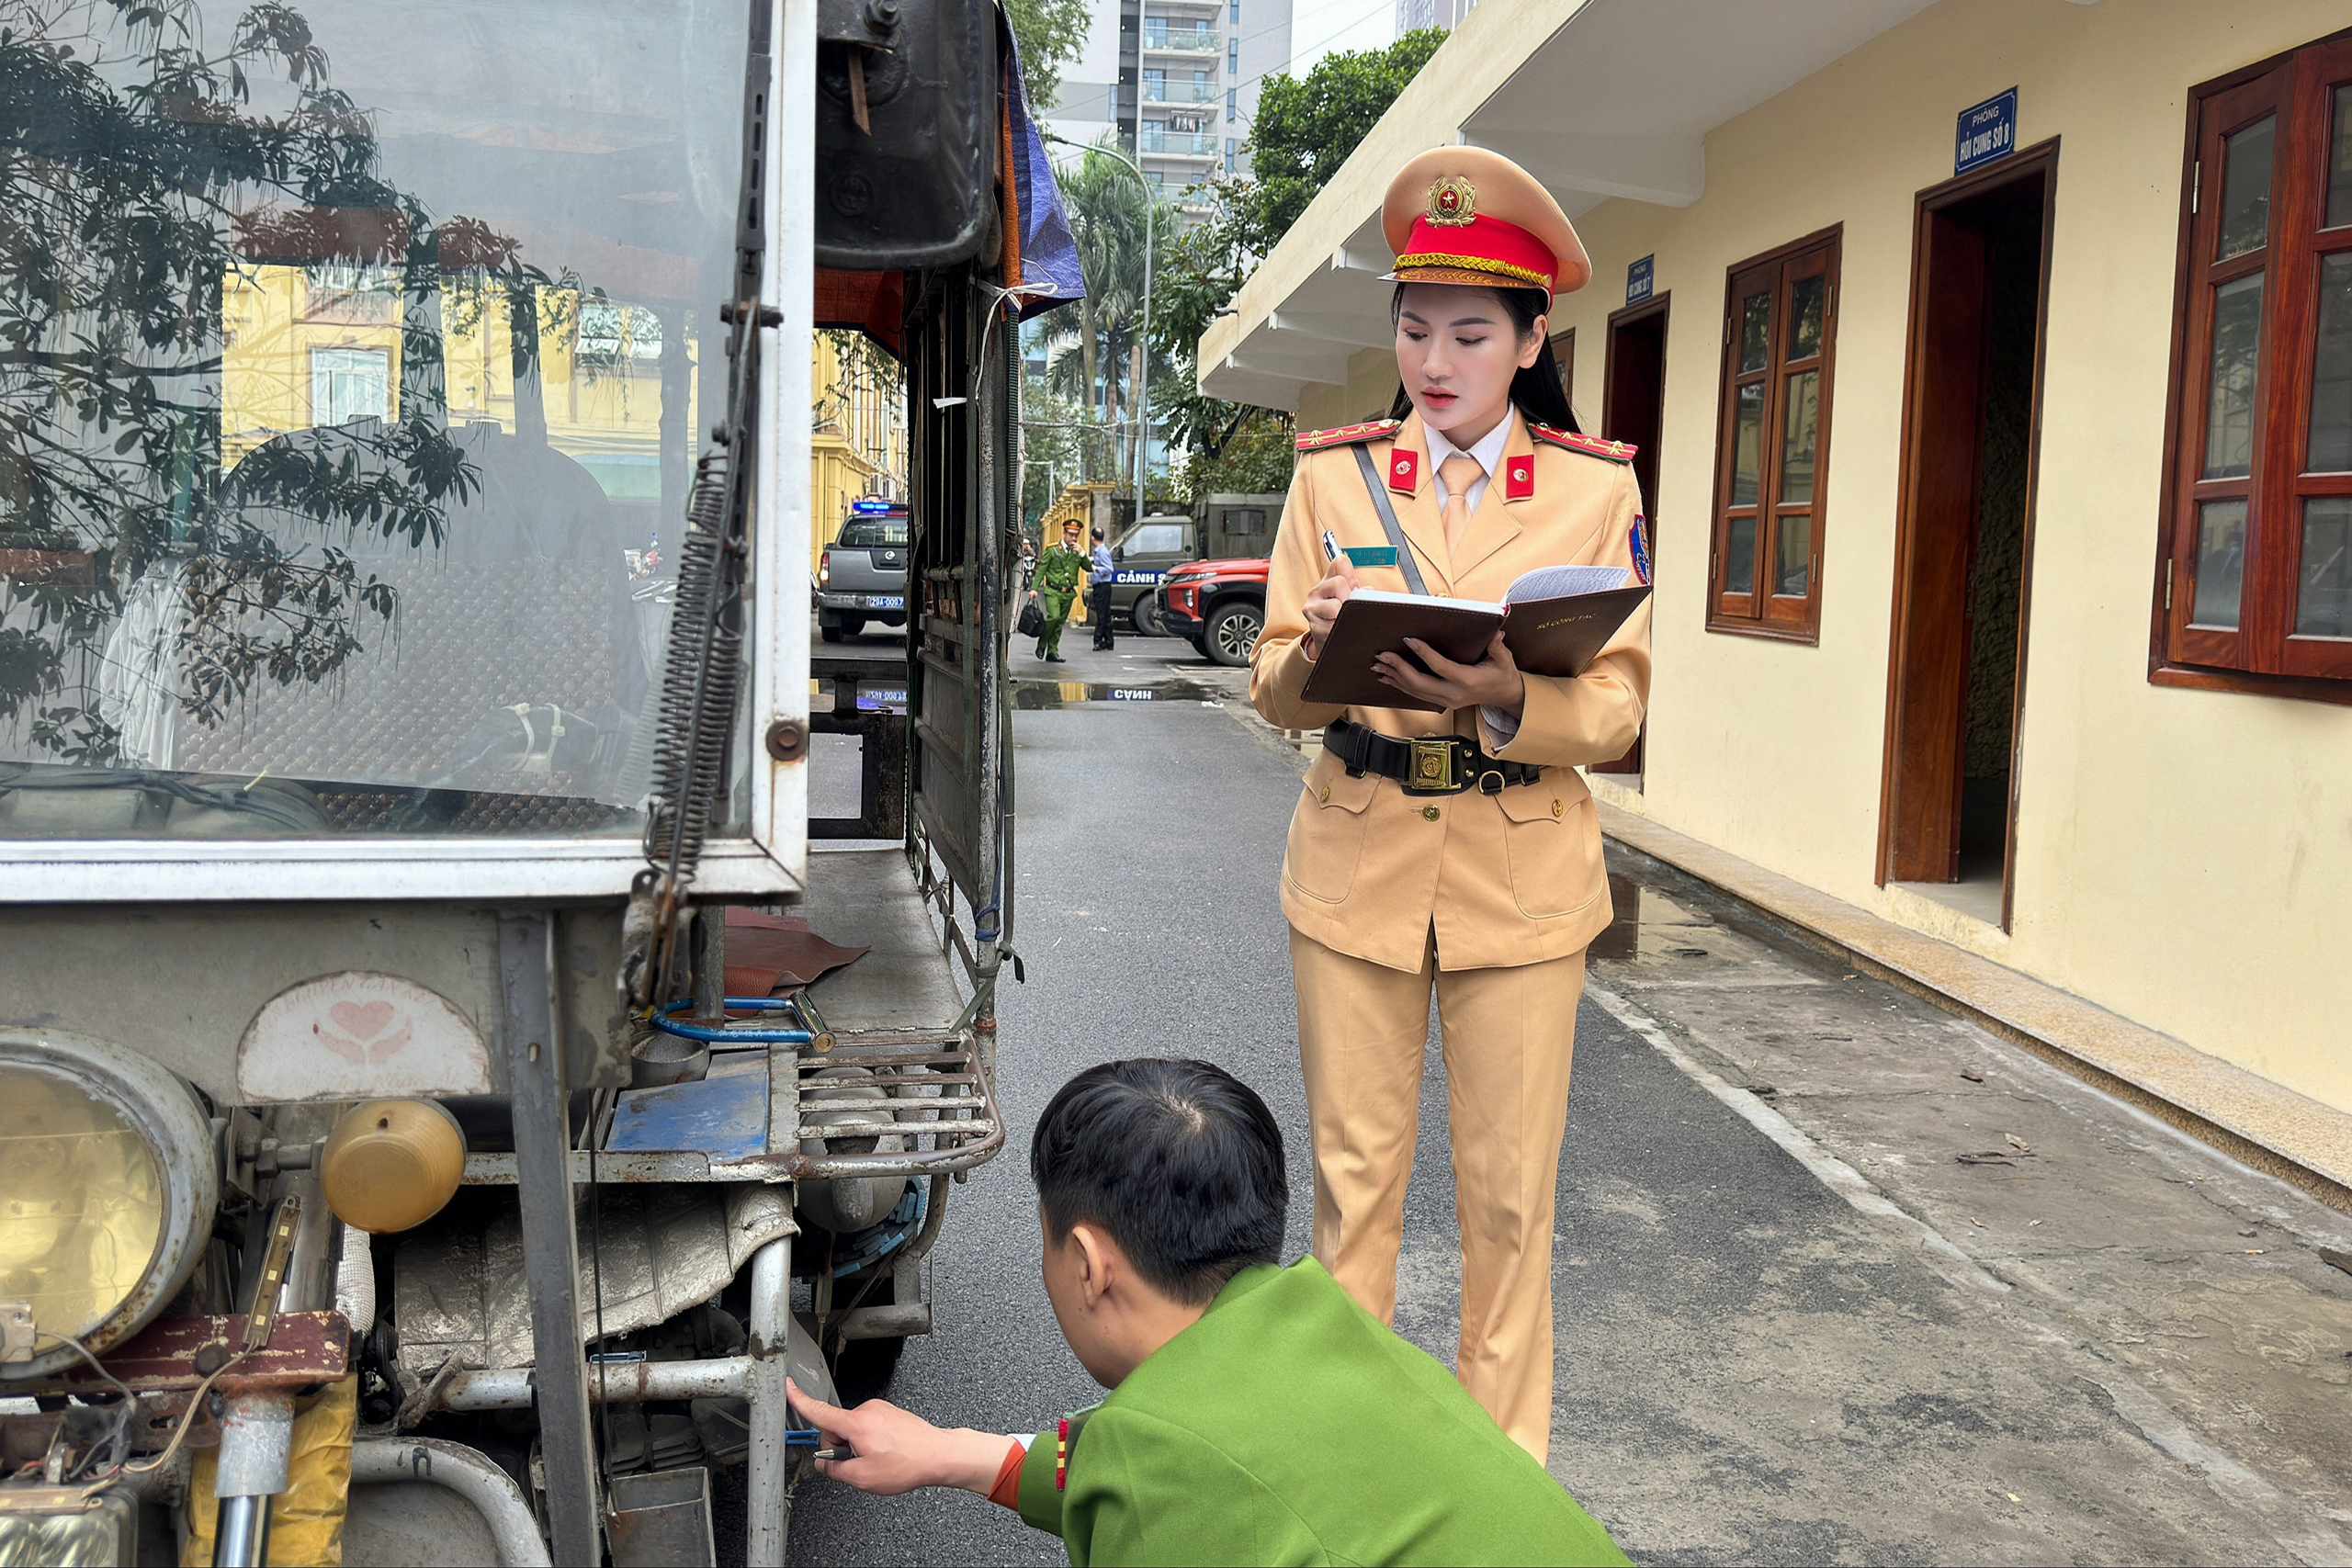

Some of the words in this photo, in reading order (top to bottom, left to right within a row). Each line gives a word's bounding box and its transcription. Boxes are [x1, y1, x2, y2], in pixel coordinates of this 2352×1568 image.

[1972, 107, 1999, 127] PHÒNG
[1973, 130, 1992, 157] CUNG
[1993, 117, 2005, 149] SỐ
[2004, 122, 2009, 144] 8
[1116, 570, 1155, 583] CẢNH
